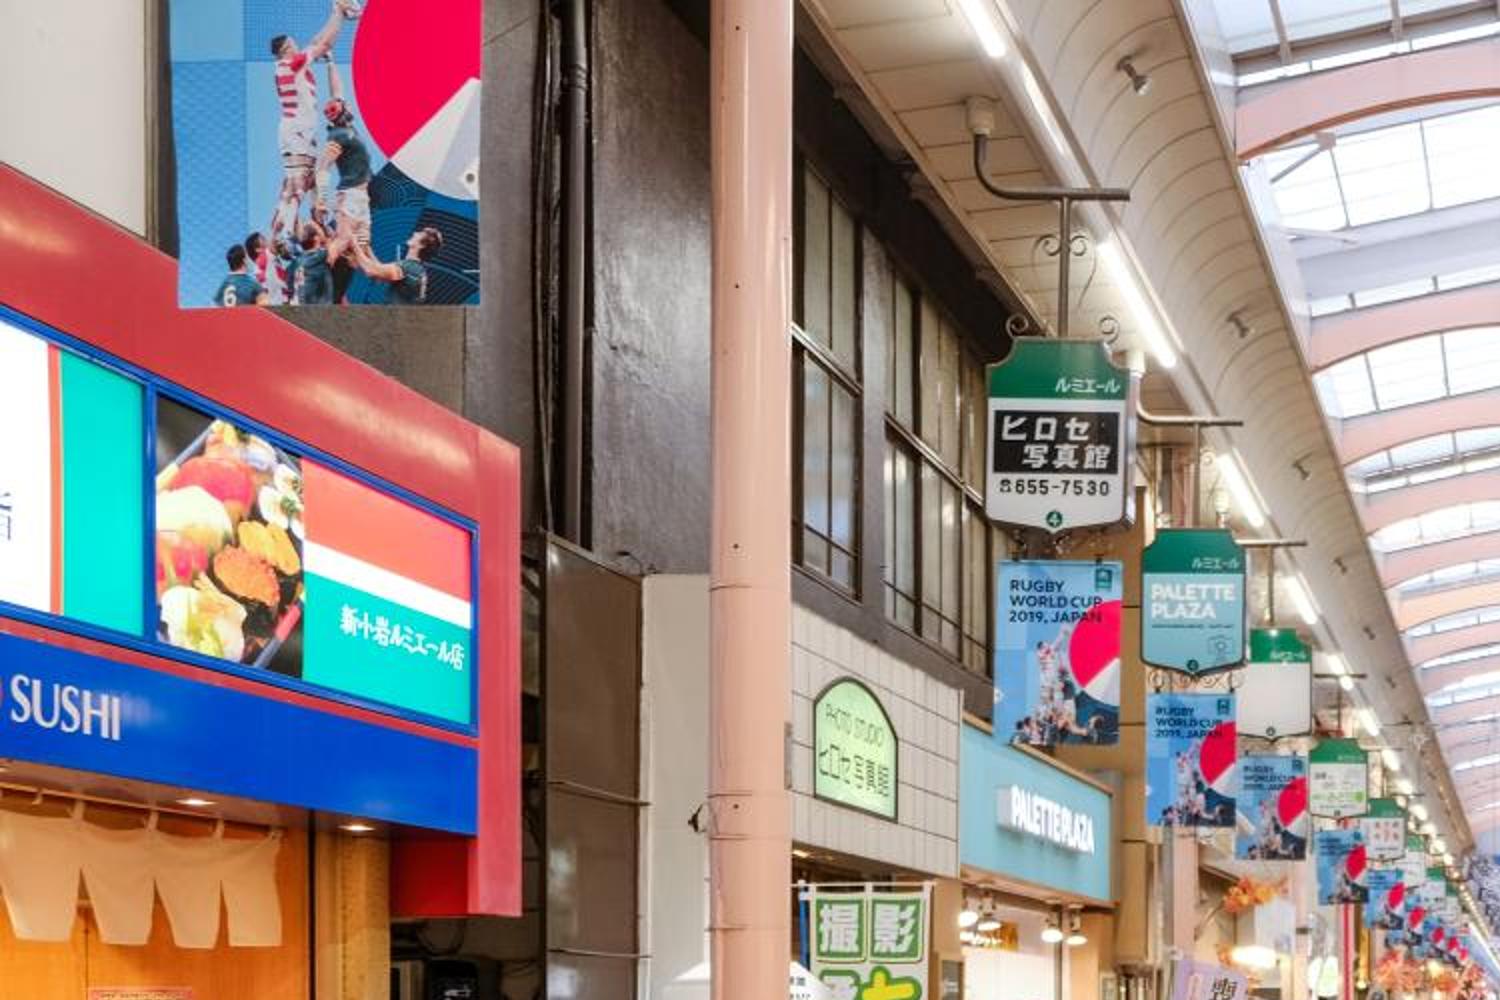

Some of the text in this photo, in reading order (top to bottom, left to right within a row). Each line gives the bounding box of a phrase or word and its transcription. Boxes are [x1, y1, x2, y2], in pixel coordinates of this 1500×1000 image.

[1055, 376, 1121, 394] ルミエール
[1001, 415, 1092, 442] ヒロセ
[1022, 444, 1112, 470] 写真館
[1015, 479, 1110, 497] 655-7530
[1192, 557, 1240, 570] ルミエール
[1009, 579, 1065, 594] RUGBY
[1151, 583, 1235, 601] PALETTE
[1009, 595, 1103, 609] WORLD CUP
[1151, 602, 1217, 619] PLAZA
[1008, 609, 1103, 625] 2019, JAPAN
[340, 603, 464, 670] 新小岩ルミエール店
[11, 673, 121, 741] SUSHI
[1155, 706, 1195, 717] RUGBY
[1155, 719, 1223, 728] WORLD CUP
[1186, 729, 1223, 738] JAPAN
[819, 904, 916, 954] 撮影
